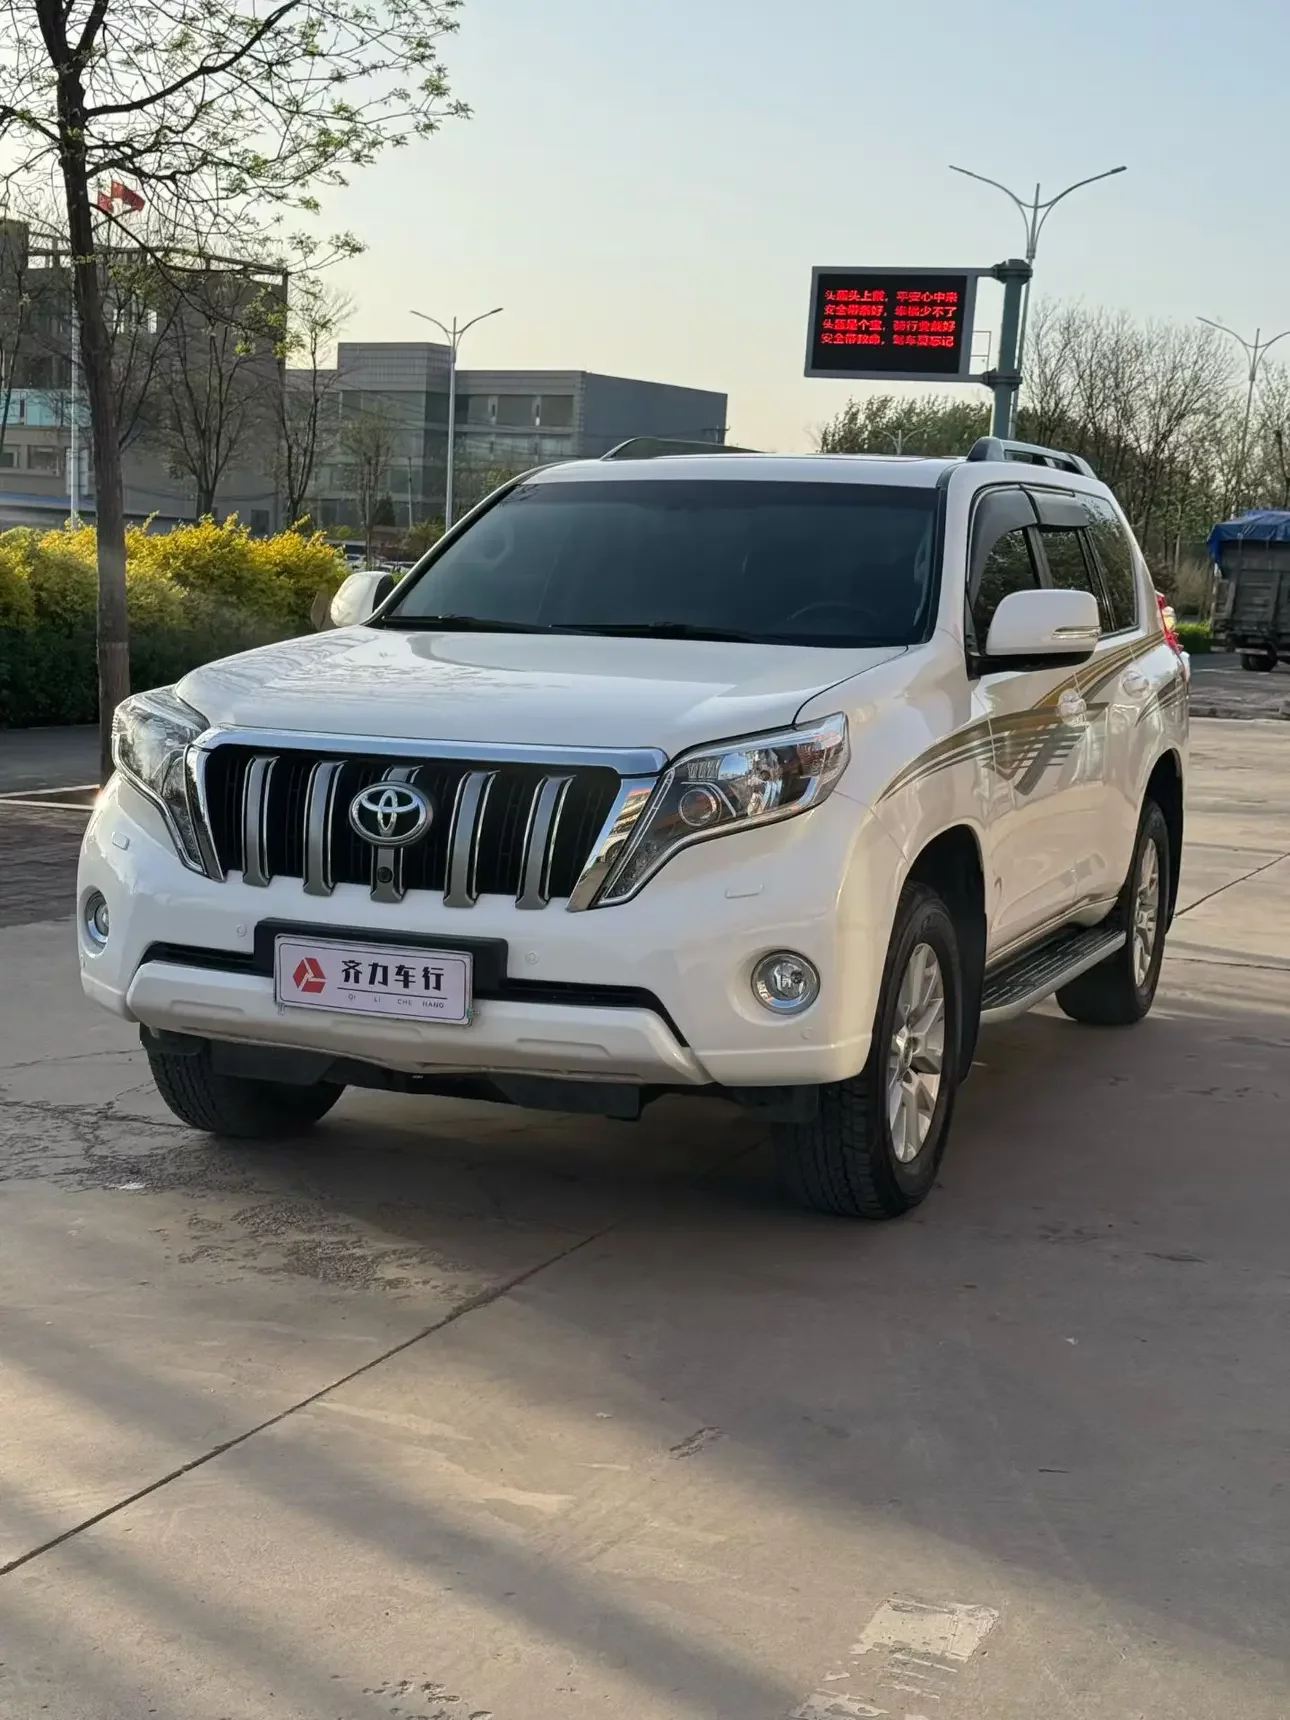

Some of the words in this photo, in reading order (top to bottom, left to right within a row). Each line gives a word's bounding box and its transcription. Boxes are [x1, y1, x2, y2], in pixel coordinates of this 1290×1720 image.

[341, 960, 444, 991] 齐力车行
[348, 994, 356, 1002] QI
